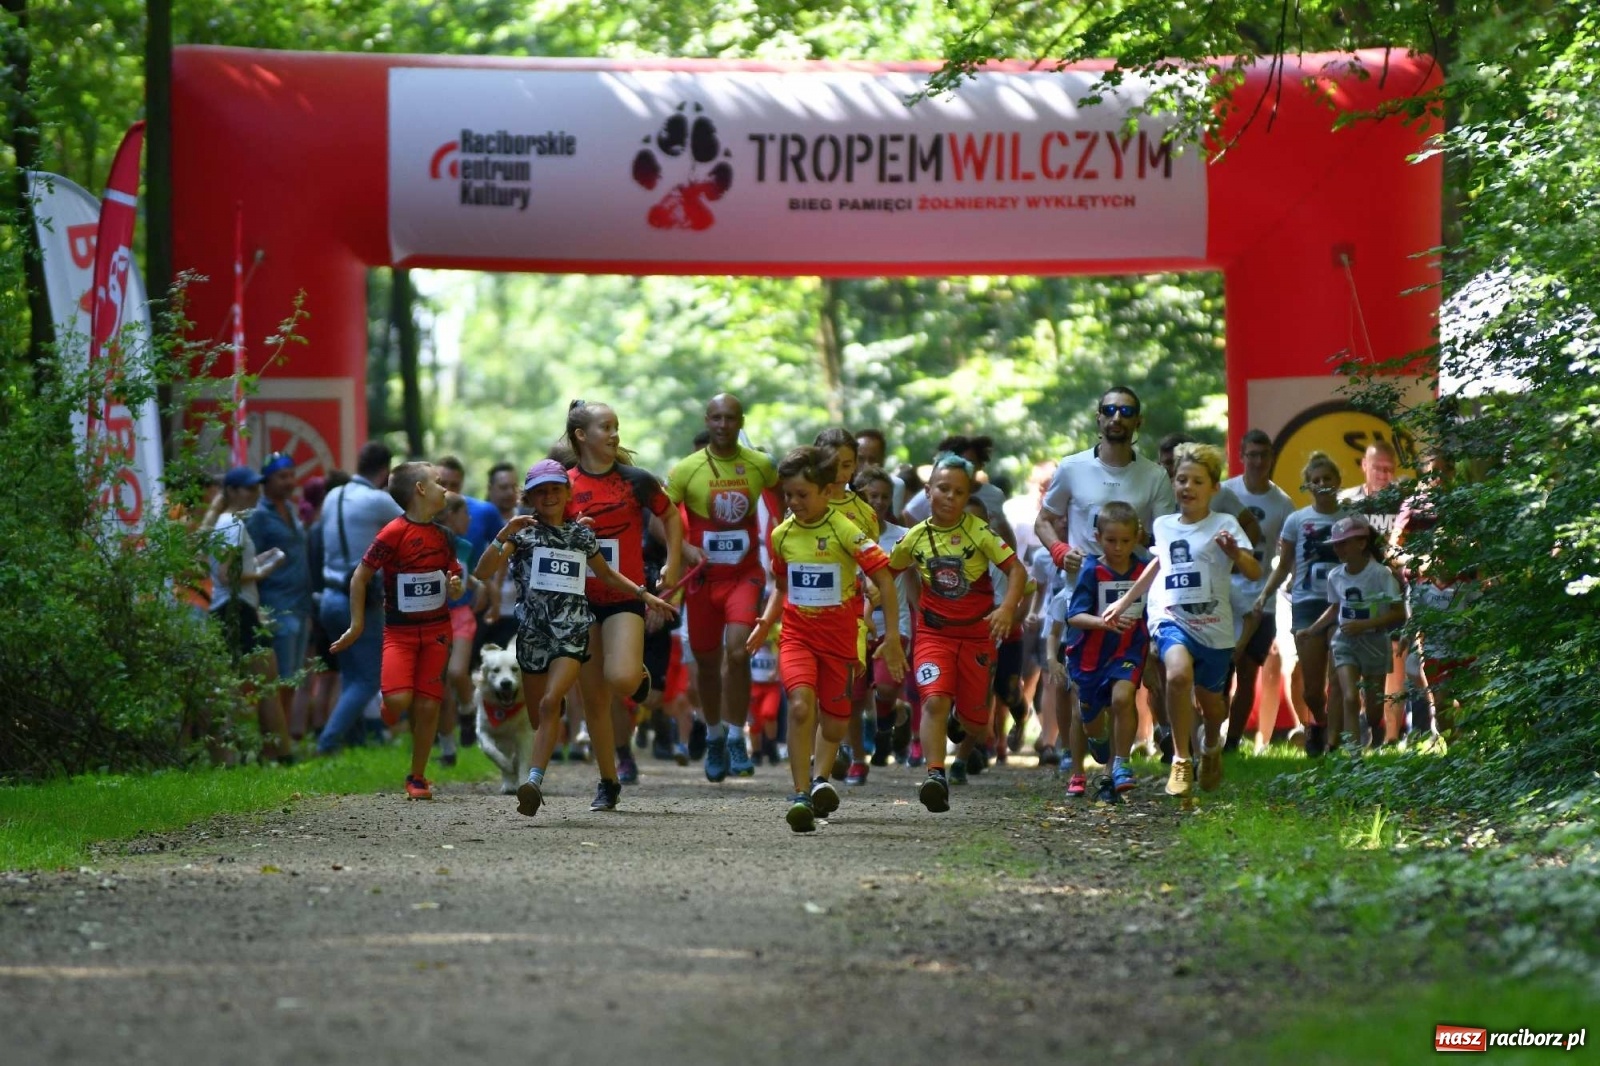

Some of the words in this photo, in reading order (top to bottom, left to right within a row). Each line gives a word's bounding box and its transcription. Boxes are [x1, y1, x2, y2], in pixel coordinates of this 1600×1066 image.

[460, 129, 576, 155] Raciborskie
[460, 180, 531, 211] Kultury
[788, 197, 833, 210] BIEG
[838, 197, 913, 213] PAMIĘCI
[1026, 193, 1137, 210] WYKLĘTYCH
[717, 540, 735, 551] 80
[549, 560, 571, 575] 96
[801, 573, 821, 587] 87
[1170, 574, 1190, 588] 16
[413, 583, 432, 596] 82
[921, 667, 933, 681] B
